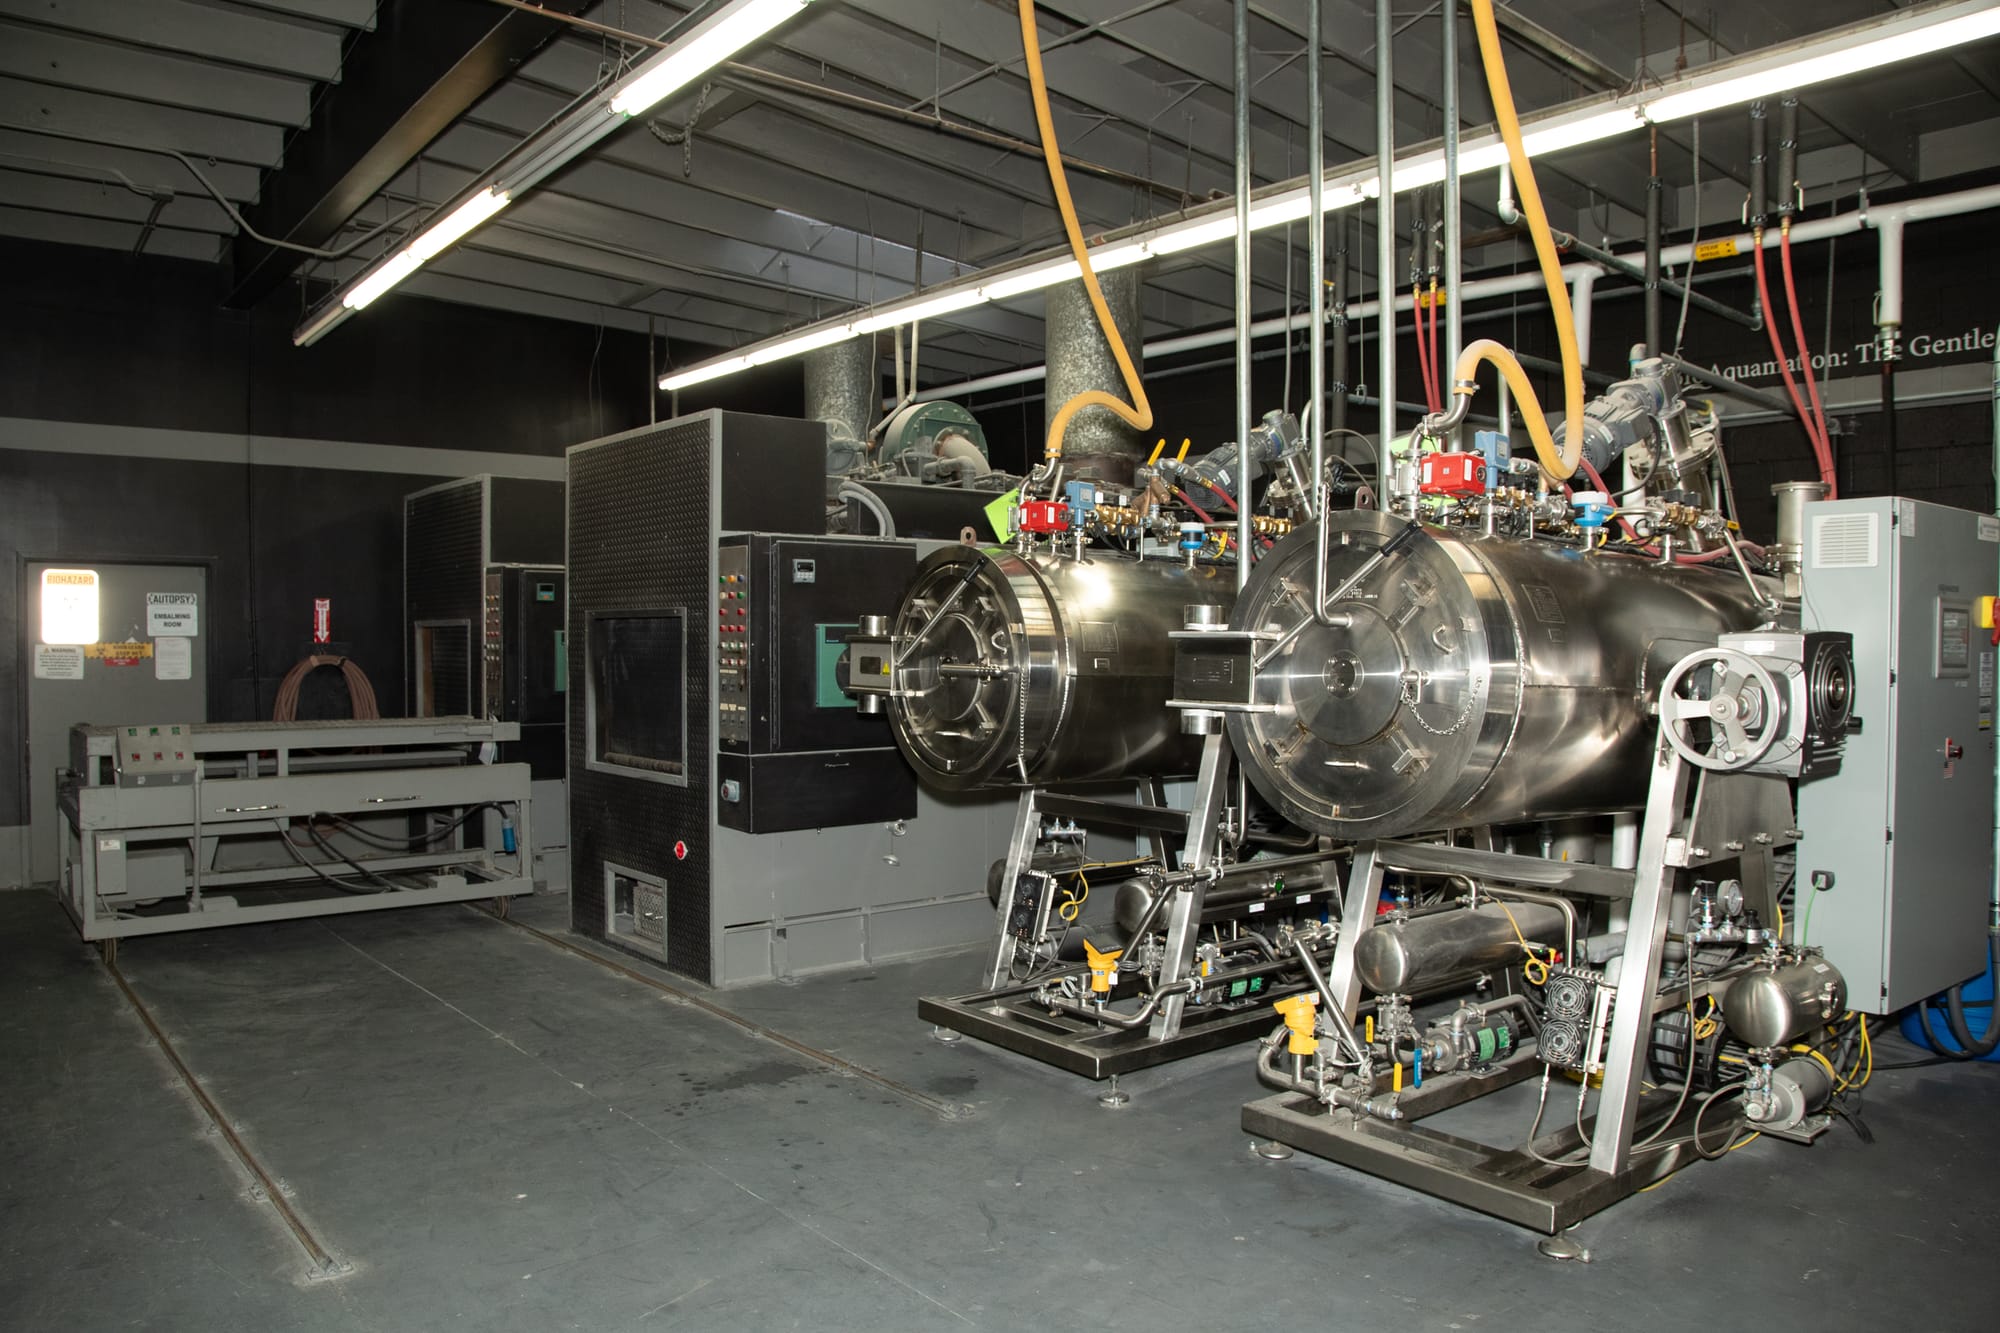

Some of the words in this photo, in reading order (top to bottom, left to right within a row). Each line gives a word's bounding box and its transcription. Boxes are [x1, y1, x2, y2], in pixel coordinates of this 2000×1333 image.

[1909, 327, 1995, 357] Gentle
[47, 575, 94, 585] BIOHAZARD
[153, 594, 191, 604] AUTOPSY
